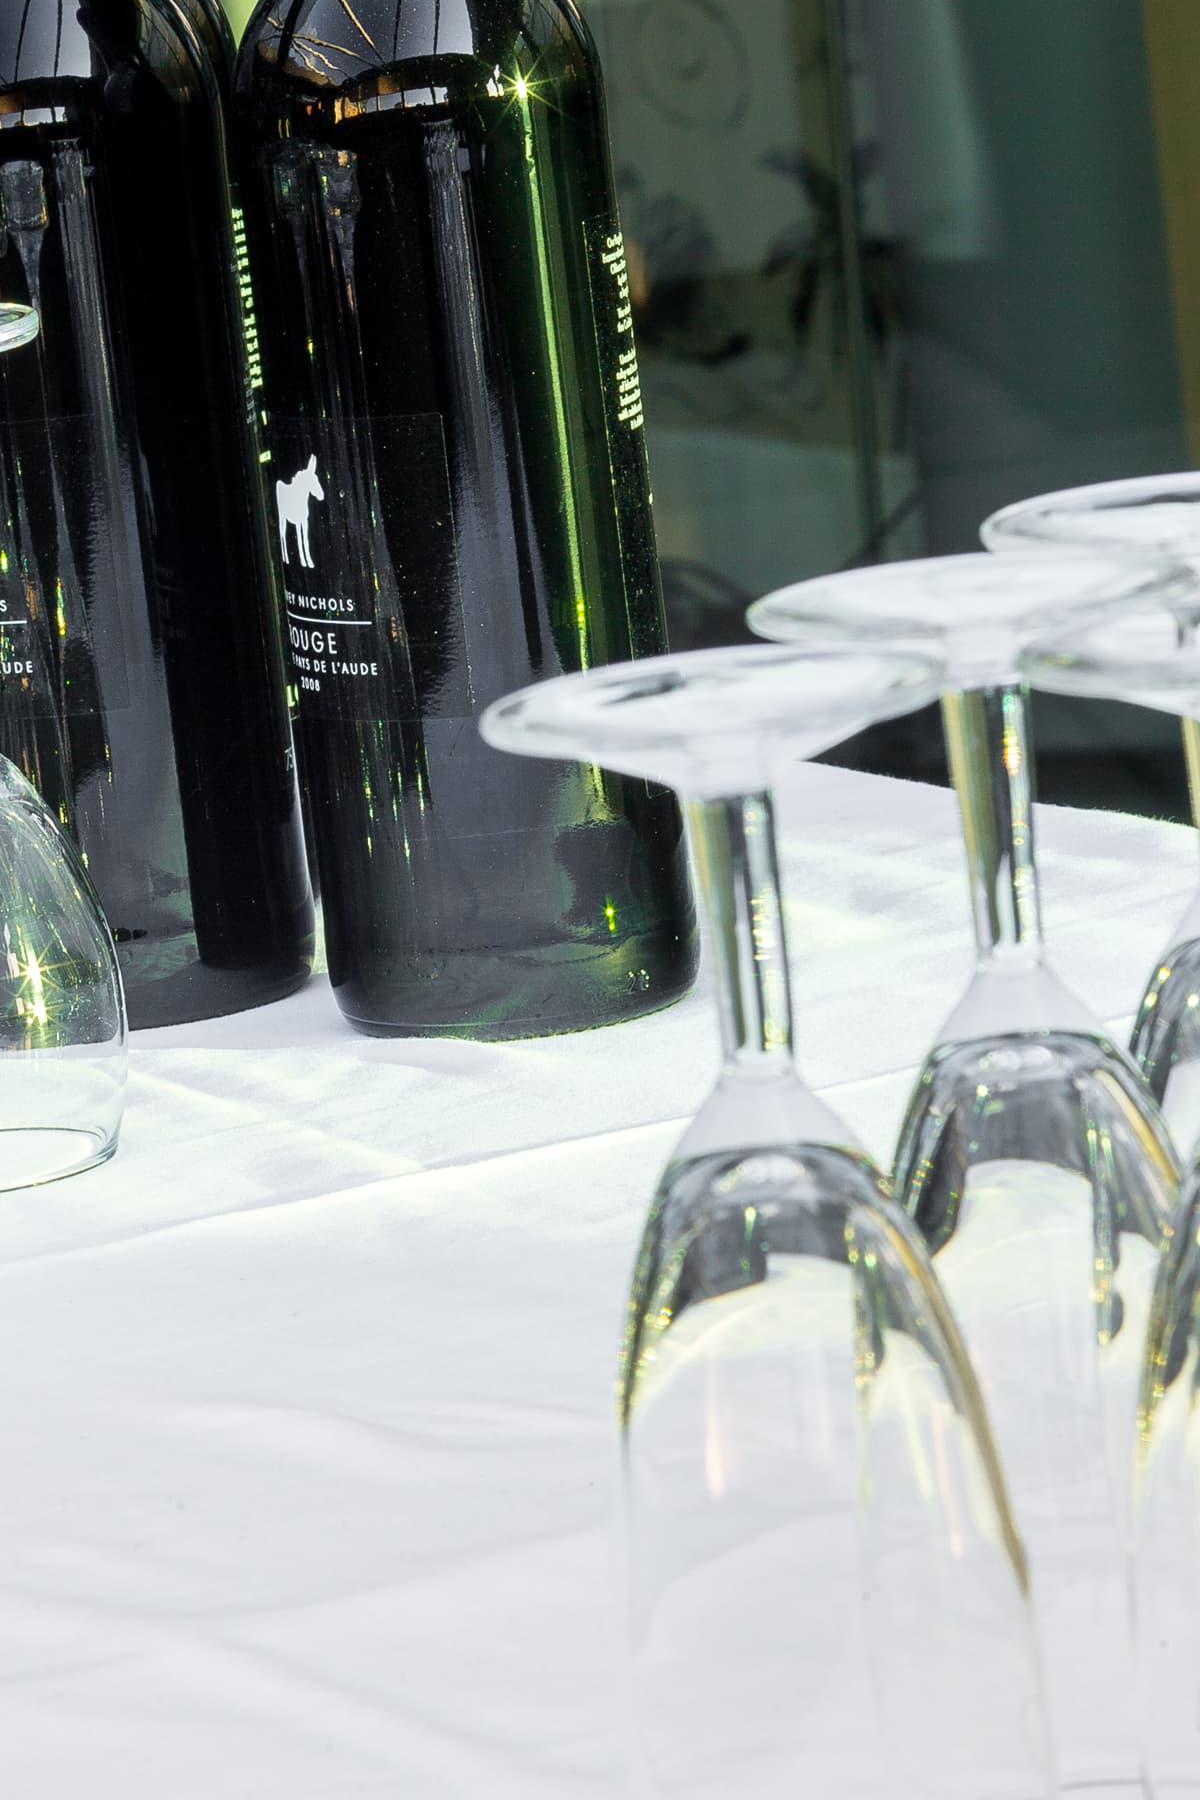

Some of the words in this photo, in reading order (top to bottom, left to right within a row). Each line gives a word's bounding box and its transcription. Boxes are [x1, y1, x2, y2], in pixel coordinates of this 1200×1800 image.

[298, 594, 354, 612] NICHOLS
[313, 659, 327, 674] DE
[331, 661, 378, 676] L'AUDE
[300, 675, 321, 692] 2008
